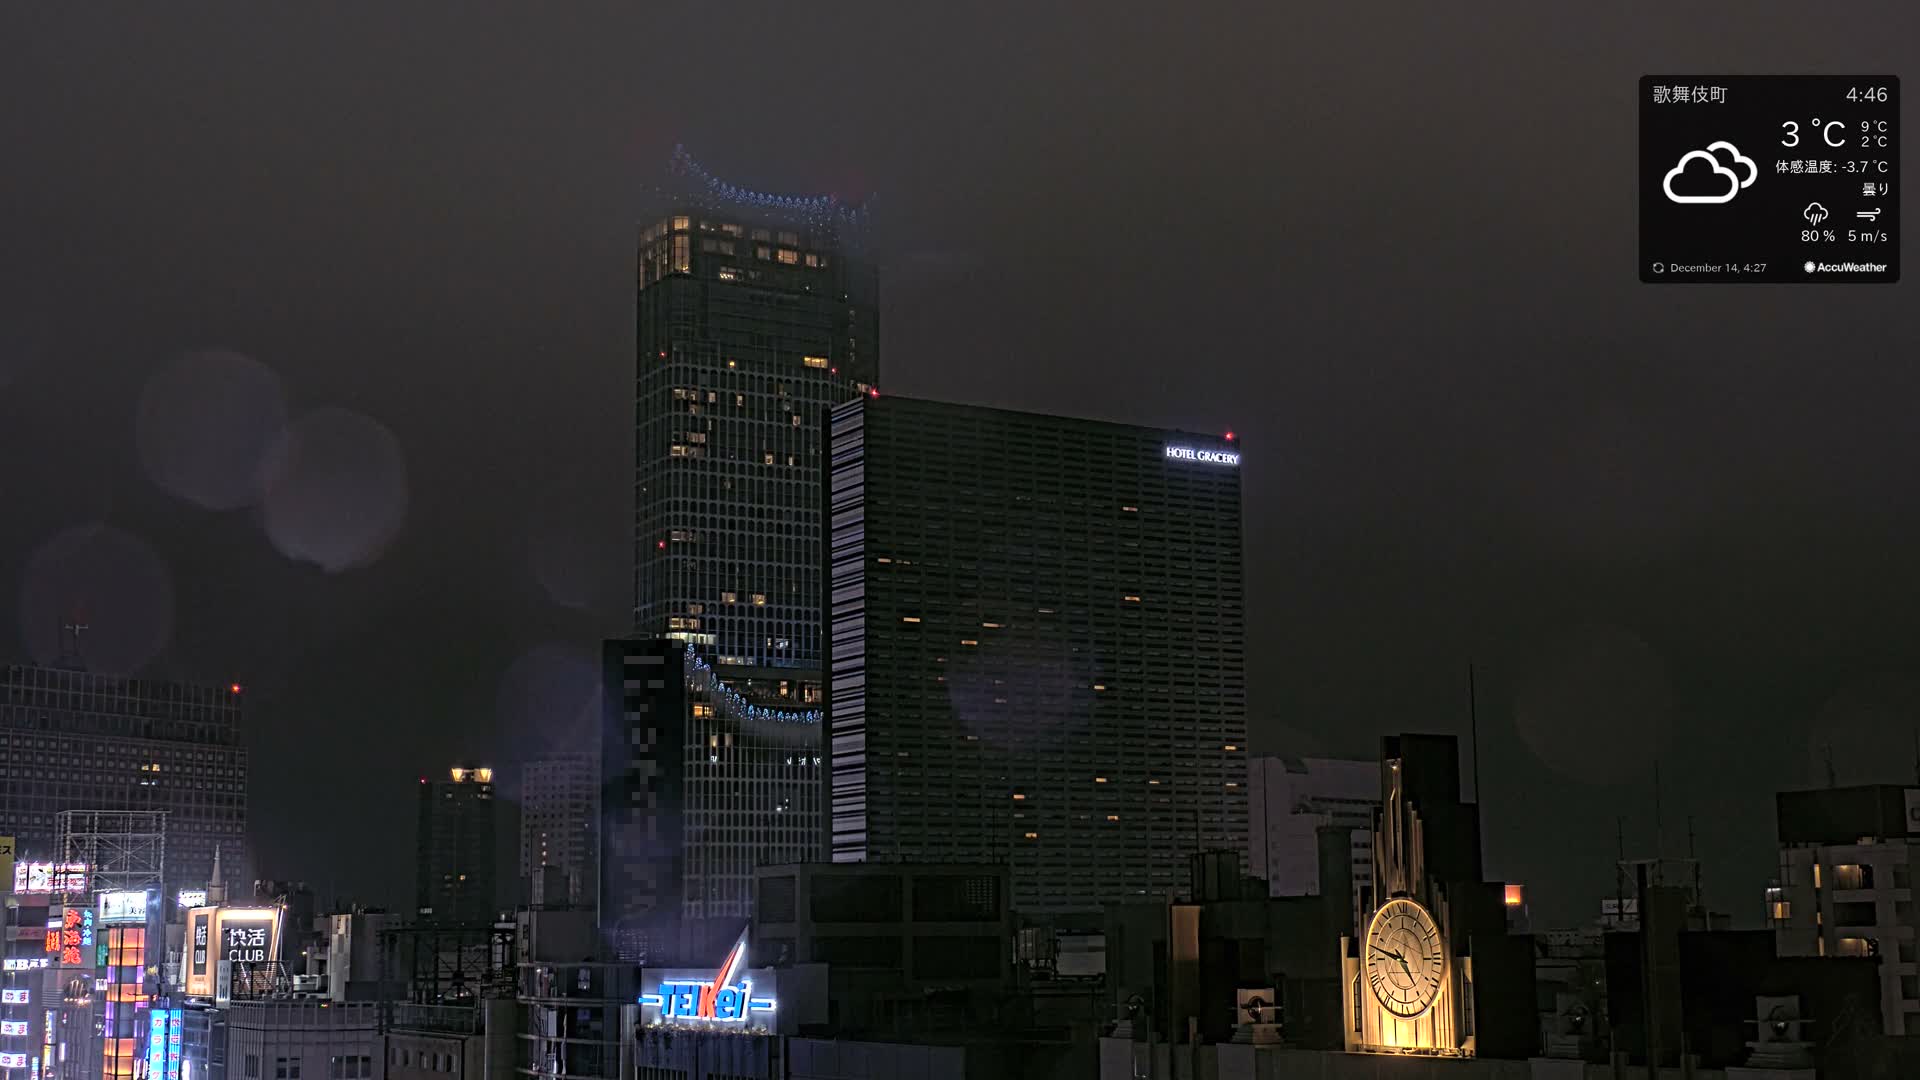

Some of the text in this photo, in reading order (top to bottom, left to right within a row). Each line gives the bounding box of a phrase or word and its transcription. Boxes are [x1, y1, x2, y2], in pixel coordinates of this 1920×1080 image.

[1166, 446, 1239, 464] HOTEL GRACERY
[229, 928, 265, 947] 快活
[229, 949, 264, 962] CLUB
